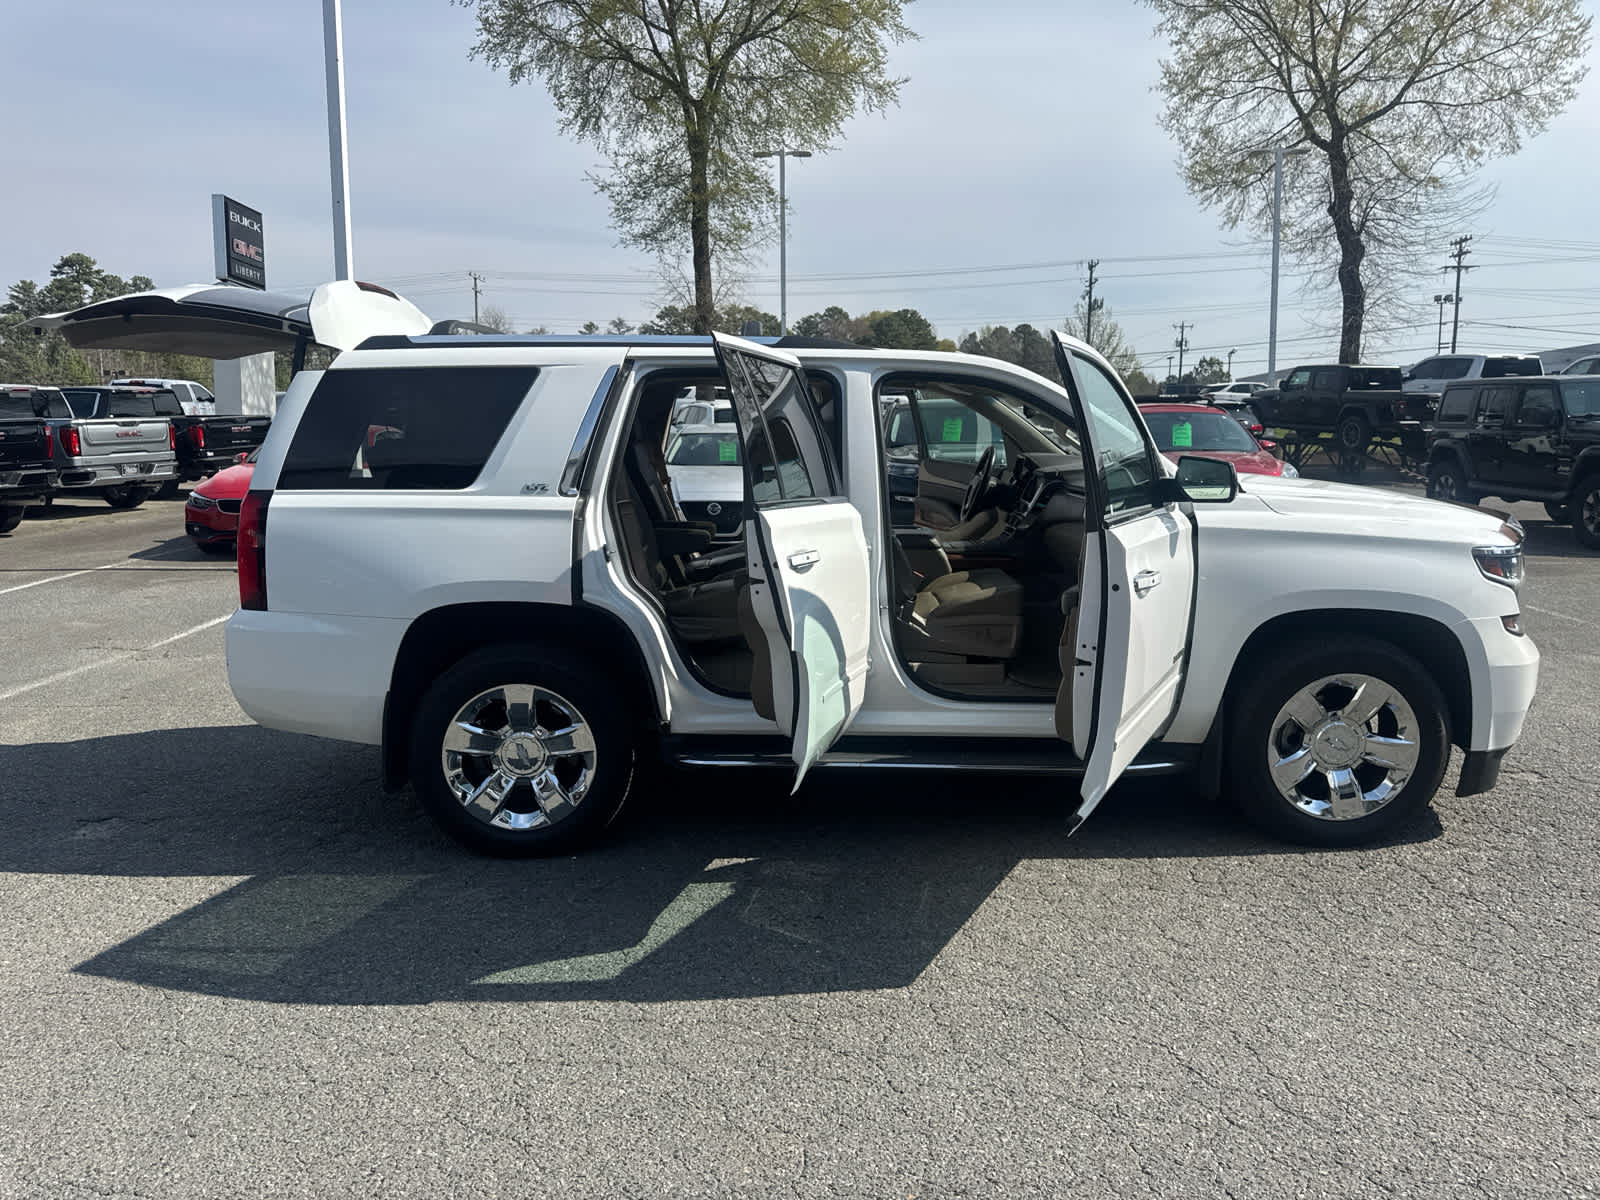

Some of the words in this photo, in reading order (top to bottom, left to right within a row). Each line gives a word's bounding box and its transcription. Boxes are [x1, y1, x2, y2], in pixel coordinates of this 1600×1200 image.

[229, 210, 261, 232] BUICK
[232, 238, 262, 262] GMC
[235, 263, 260, 281] LIBERTY
[116, 430, 143, 439] GMC
